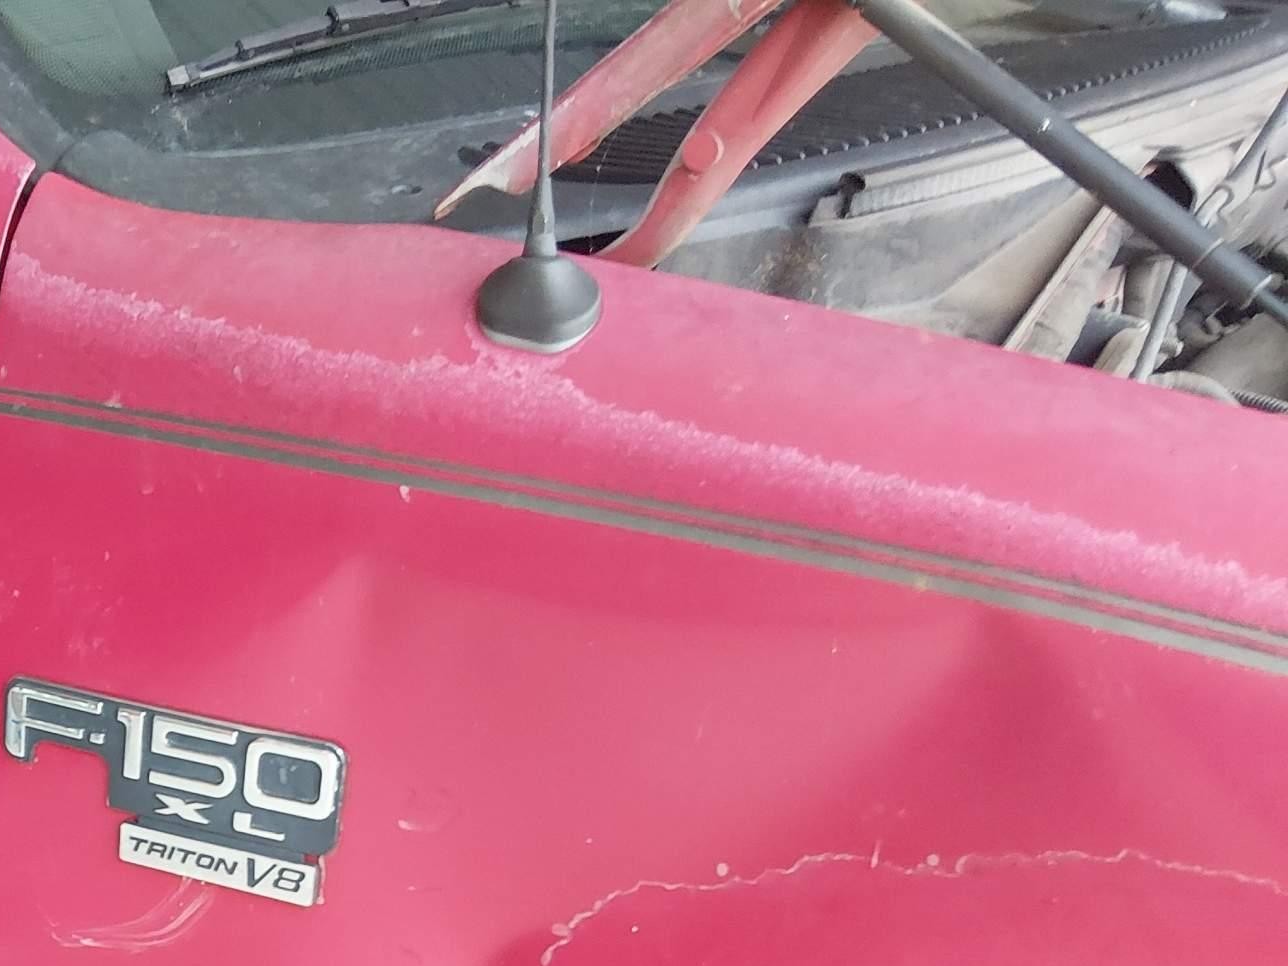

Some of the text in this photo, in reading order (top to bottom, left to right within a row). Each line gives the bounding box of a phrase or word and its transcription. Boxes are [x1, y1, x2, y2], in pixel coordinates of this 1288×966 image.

[5, 685, 340, 820] F-150
[129, 836, 306, 894] TRITON V8
